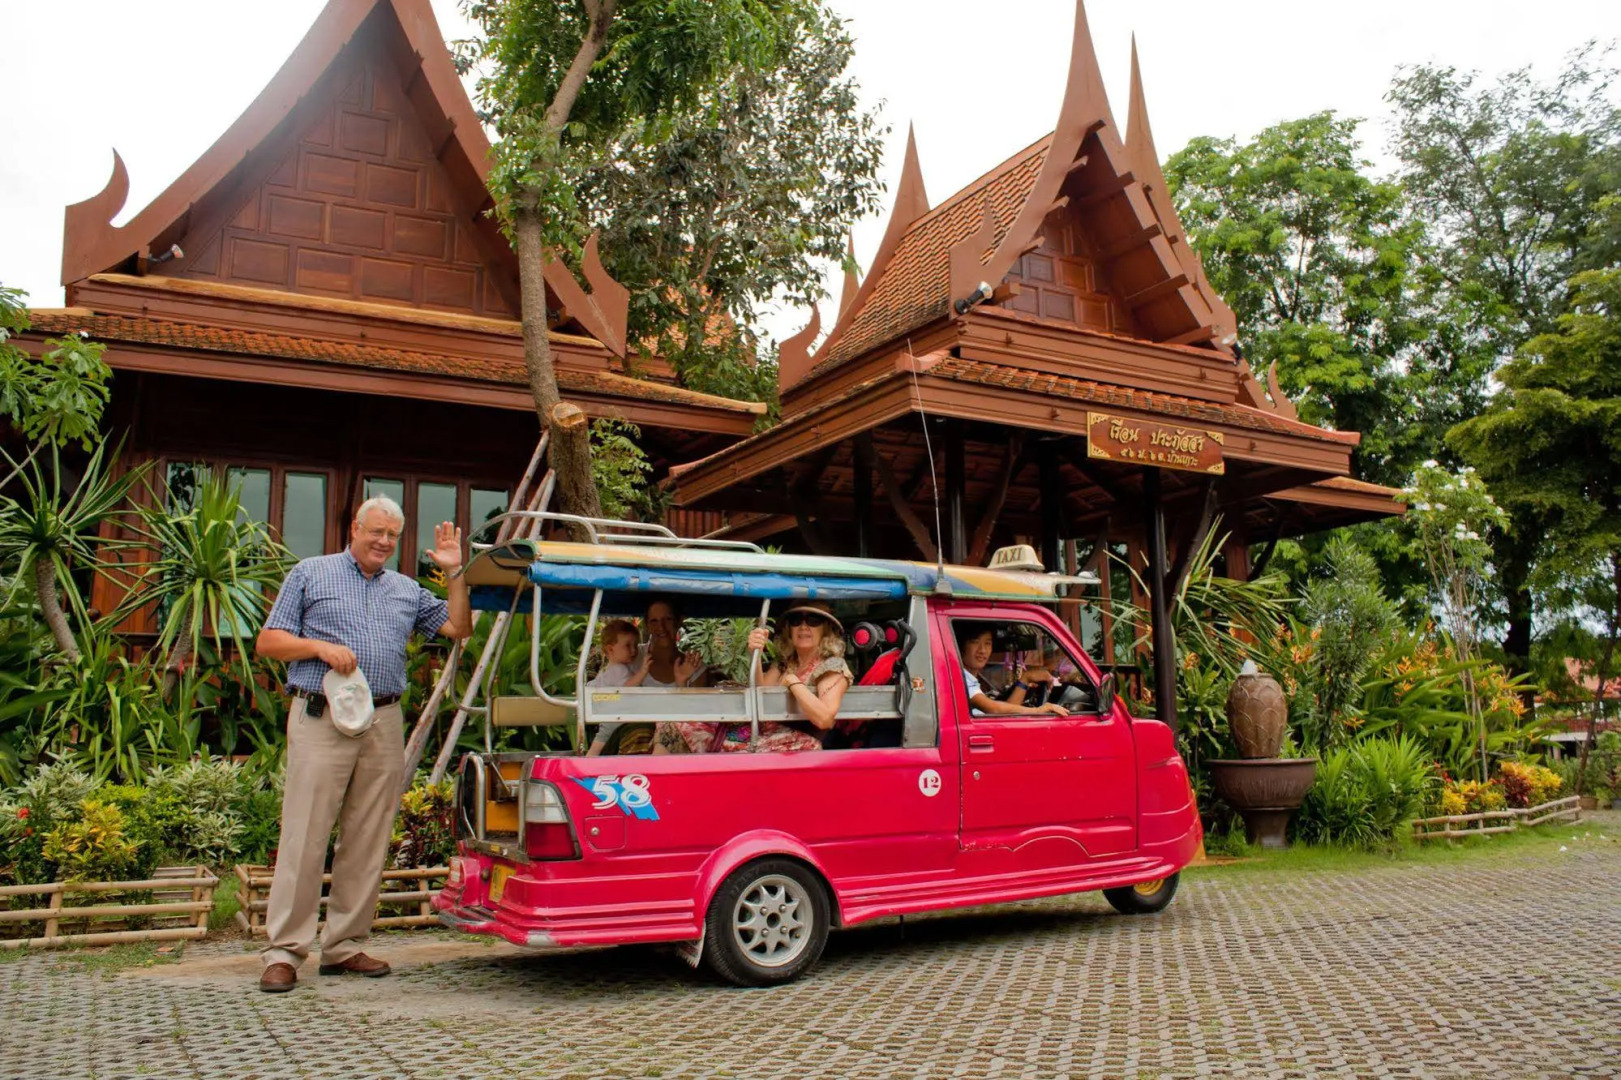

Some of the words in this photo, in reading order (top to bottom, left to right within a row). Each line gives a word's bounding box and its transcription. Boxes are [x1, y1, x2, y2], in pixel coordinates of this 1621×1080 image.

[1110, 419, 1140, 443] เรือน
[996, 547, 1022, 564] TAXI
[591, 773, 652, 809] 58
[923, 776, 940, 789] 12
